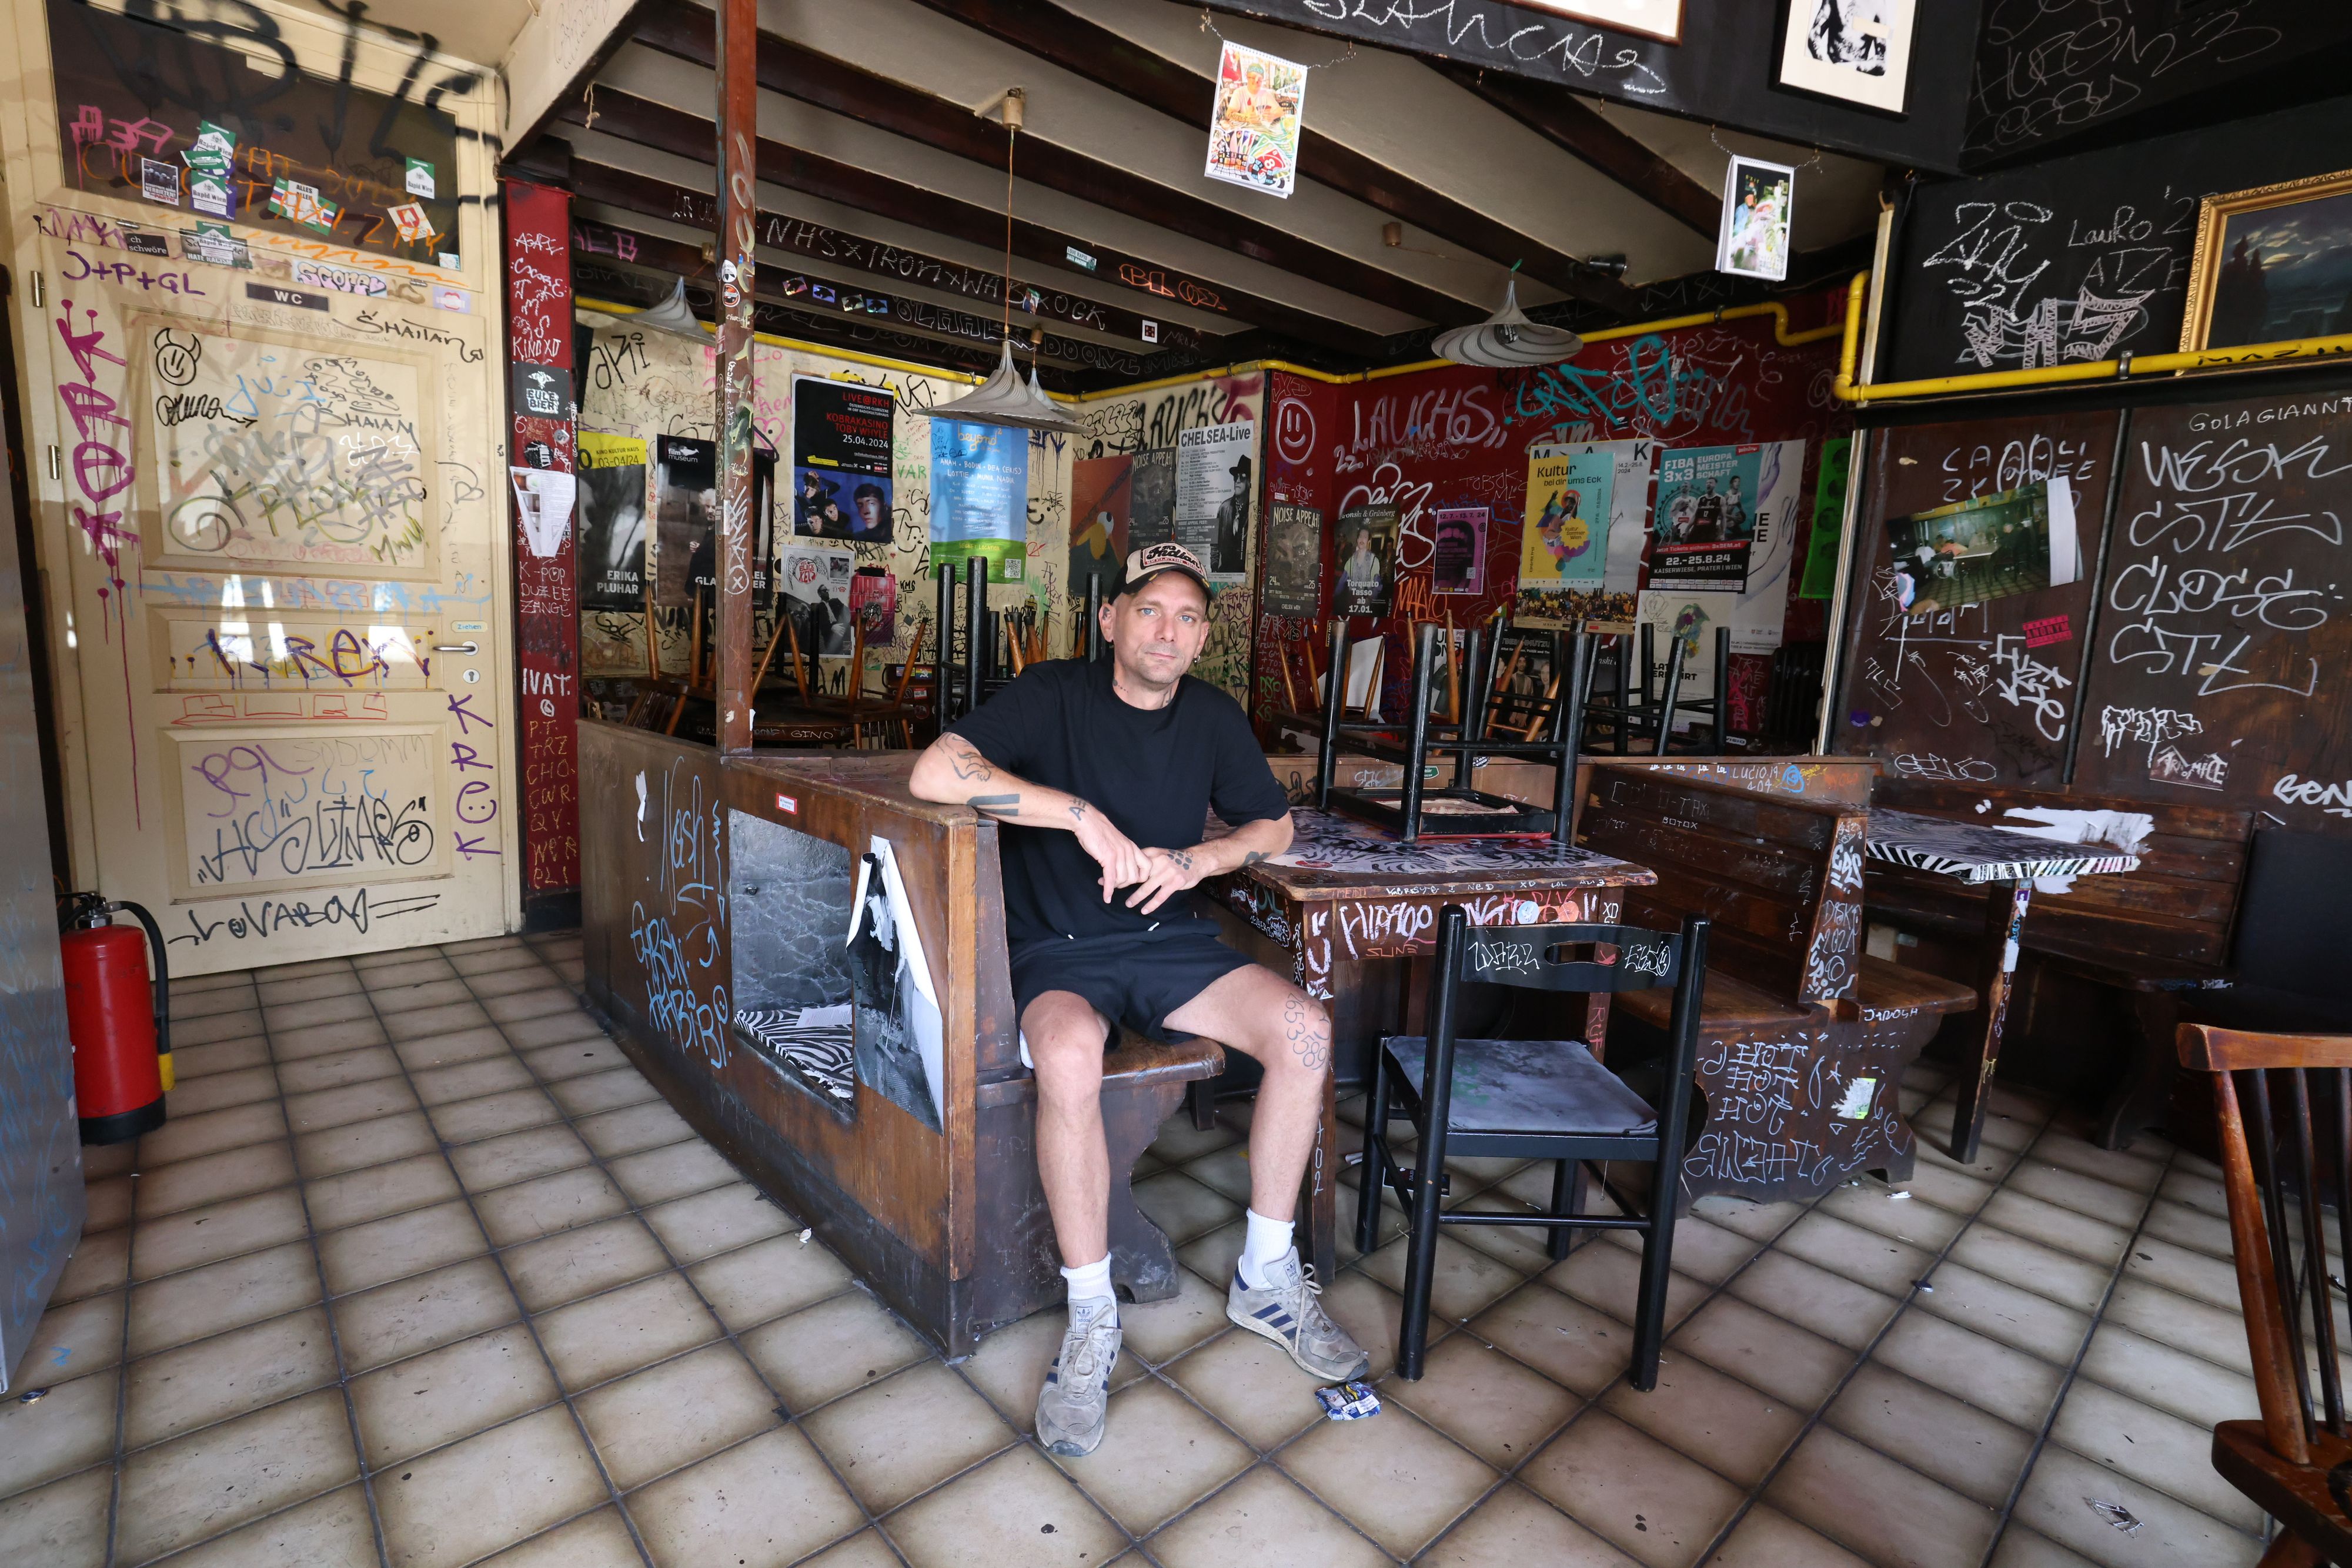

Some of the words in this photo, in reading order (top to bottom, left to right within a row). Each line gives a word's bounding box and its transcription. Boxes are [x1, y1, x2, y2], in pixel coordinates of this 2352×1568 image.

[296, 183, 313, 194] ALLES
[193, 189, 210, 199] Rapid
[212, 194, 226, 203] Wien
[131, 236, 141, 244] ch
[128, 245, 168, 255] schwöre
[274, 290, 303, 305] WC
[526, 388, 556, 403] EULE
[842, 391, 889, 408] LIVE@RKH
[529, 399, 554, 410] BIER
[826, 412, 888, 430] KOBRAKASINO
[835, 423, 857, 433] TOBY
[860, 427, 888, 439] WHYLE
[1181, 424, 1251, 448] CHELSEA-Live
[843, 434, 888, 449] 25.04.2024
[608, 447, 624, 455] KULTUR
[668, 447, 681, 456] film
[1633, 442, 1649, 460] K
[598, 454, 639, 469] 03-04/24
[668, 454, 698, 463] museum
[1132, 452, 1149, 473] NOISE
[1697, 452, 1732, 463] EUROPA
[964, 460, 981, 470] BODIN
[1665, 457, 1694, 470] FIBA
[1697, 460, 1738, 472] MEISTER
[947, 469, 969, 479] LOTTIE
[1537, 465, 1576, 478] Kultur
[1663, 468, 1694, 483] 3x3
[1696, 469, 1731, 480] SCHAFT
[1568, 477, 1585, 485] ums
[1586, 476, 1602, 484] Eck
[1273, 507, 1294, 527] NOISE
[1368, 509, 1396, 517] Grünberg
[1146, 546, 1201, 569] Indian
[1666, 554, 1730, 566] 22.-25.8.24
[607, 570, 639, 582] ERIKA
[799, 570, 816, 583] KEYS
[597, 582, 639, 594] PLUHAR
[1347, 579, 1379, 588] Torquato
[1348, 605, 1373, 613] 17.01.
[456, 623, 482, 631] Ziehen
[790, 730, 834, 740] GINO
[1662, 816, 1698, 830] BOTOX
